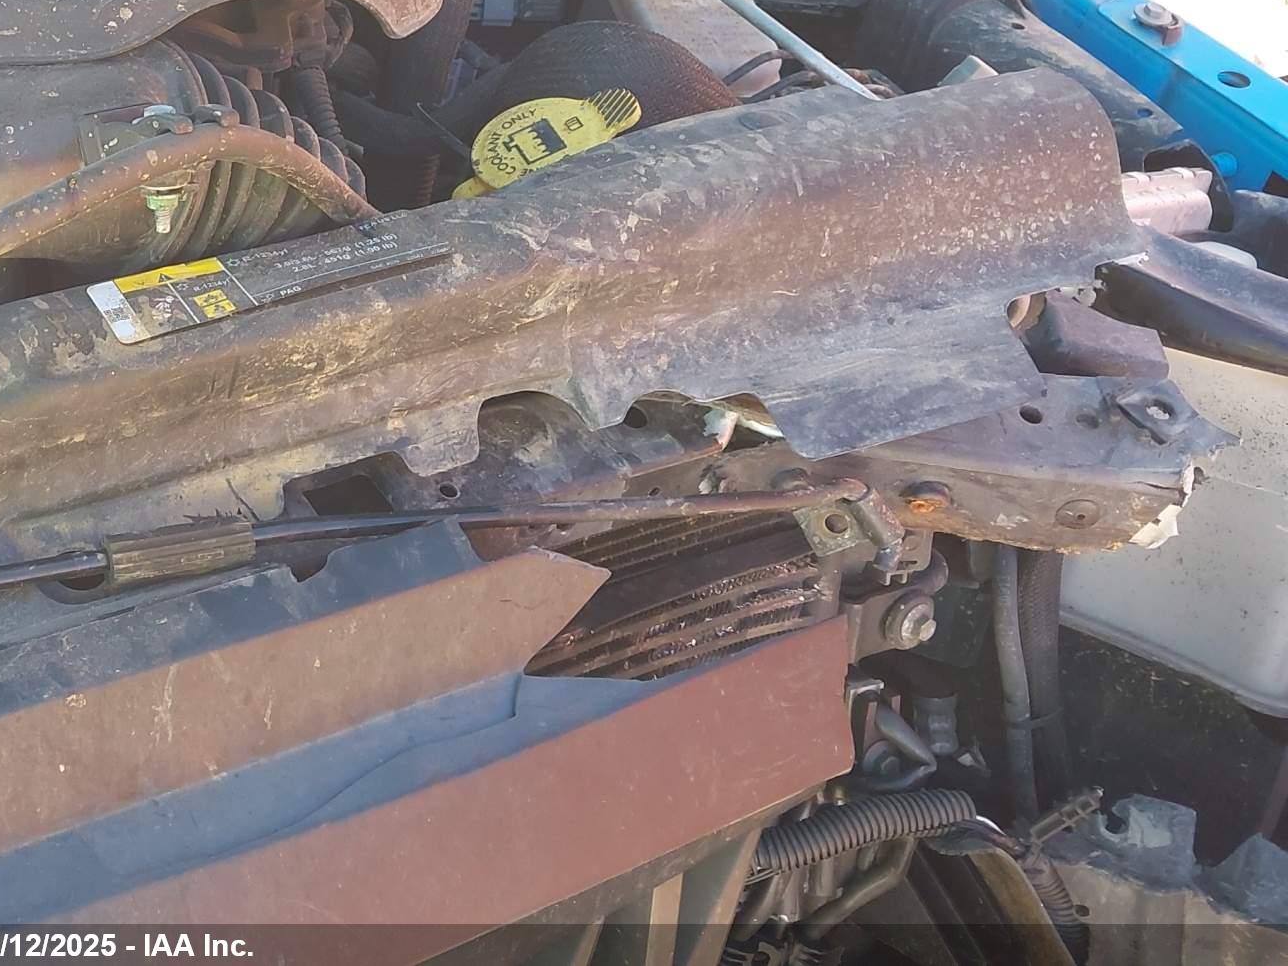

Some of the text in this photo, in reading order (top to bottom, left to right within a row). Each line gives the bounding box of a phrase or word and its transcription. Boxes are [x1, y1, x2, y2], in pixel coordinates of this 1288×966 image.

[487, 130, 516, 175] COOLANT
[502, 107, 537, 130] ONLY
[279, 285, 302, 298] PAG
